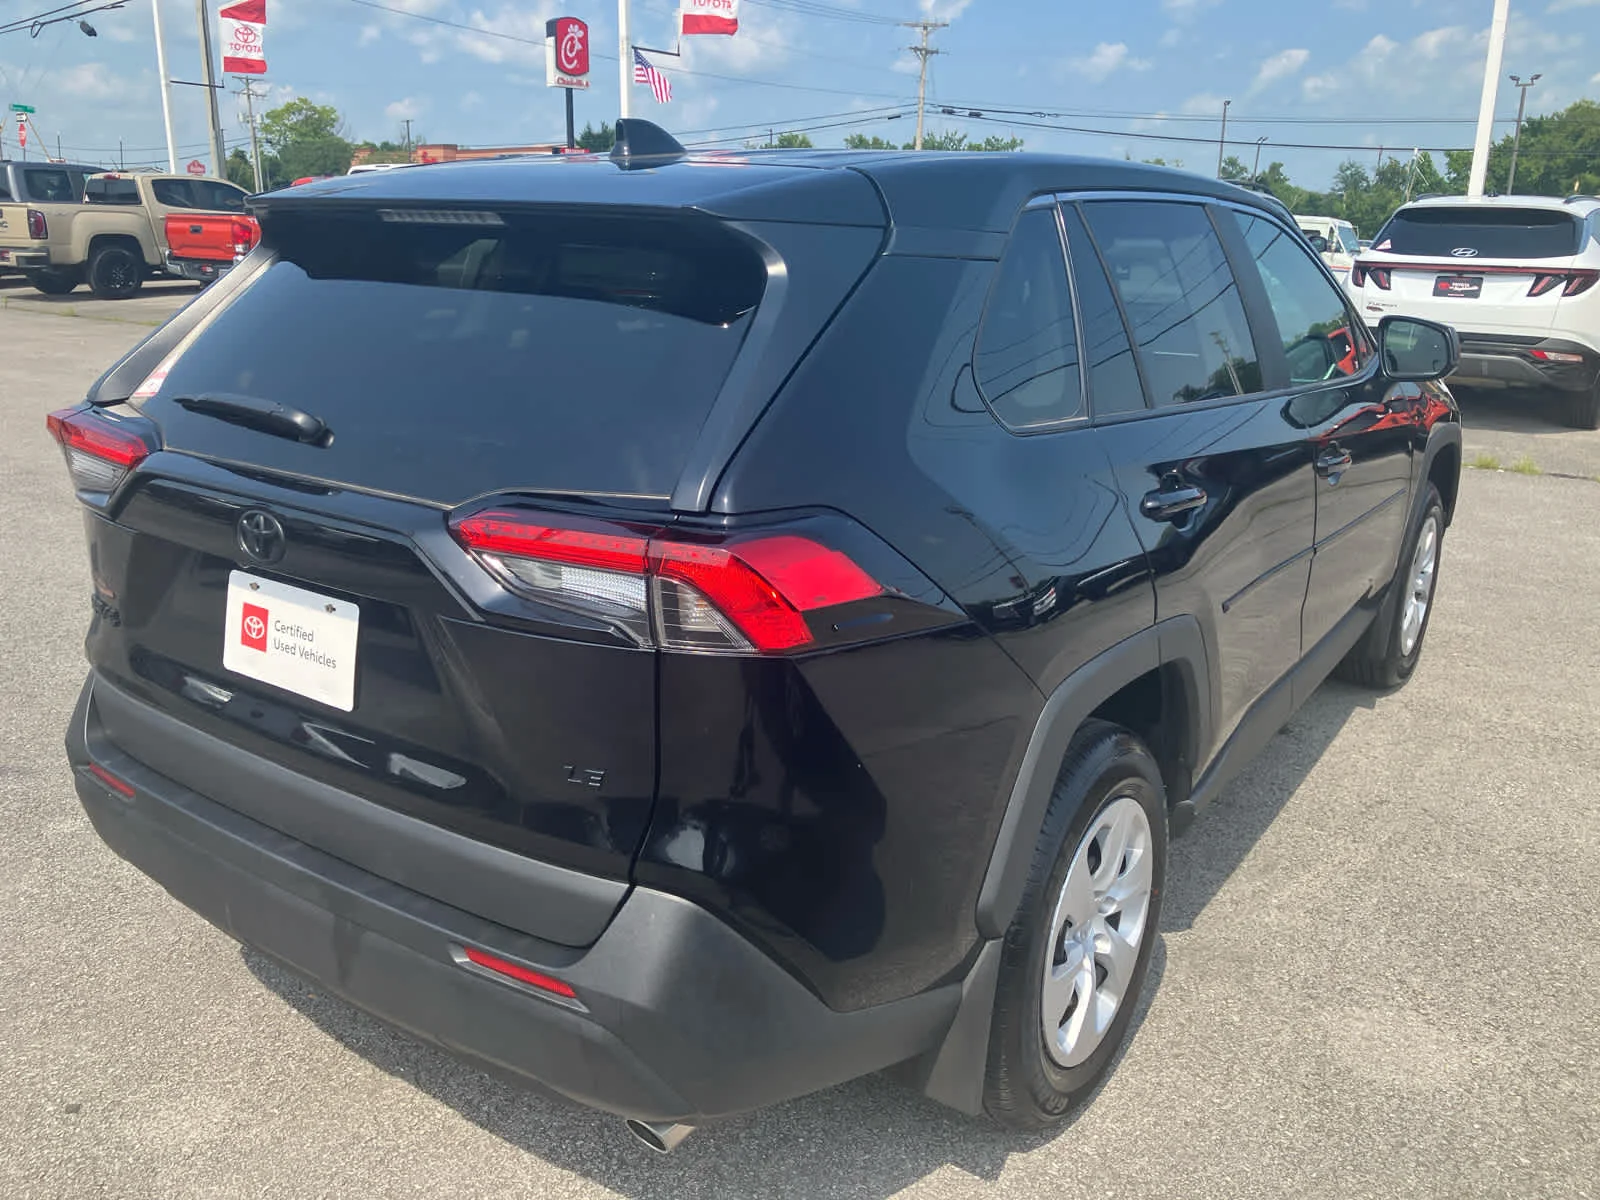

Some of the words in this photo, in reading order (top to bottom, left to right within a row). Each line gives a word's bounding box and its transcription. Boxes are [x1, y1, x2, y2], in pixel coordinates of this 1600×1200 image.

[229, 42, 262, 53] TOYOTA
[274, 620, 314, 642] Certified
[273, 638, 297, 656] Used
[298, 645, 337, 669] Vehicles
[562, 764, 606, 788] LE
